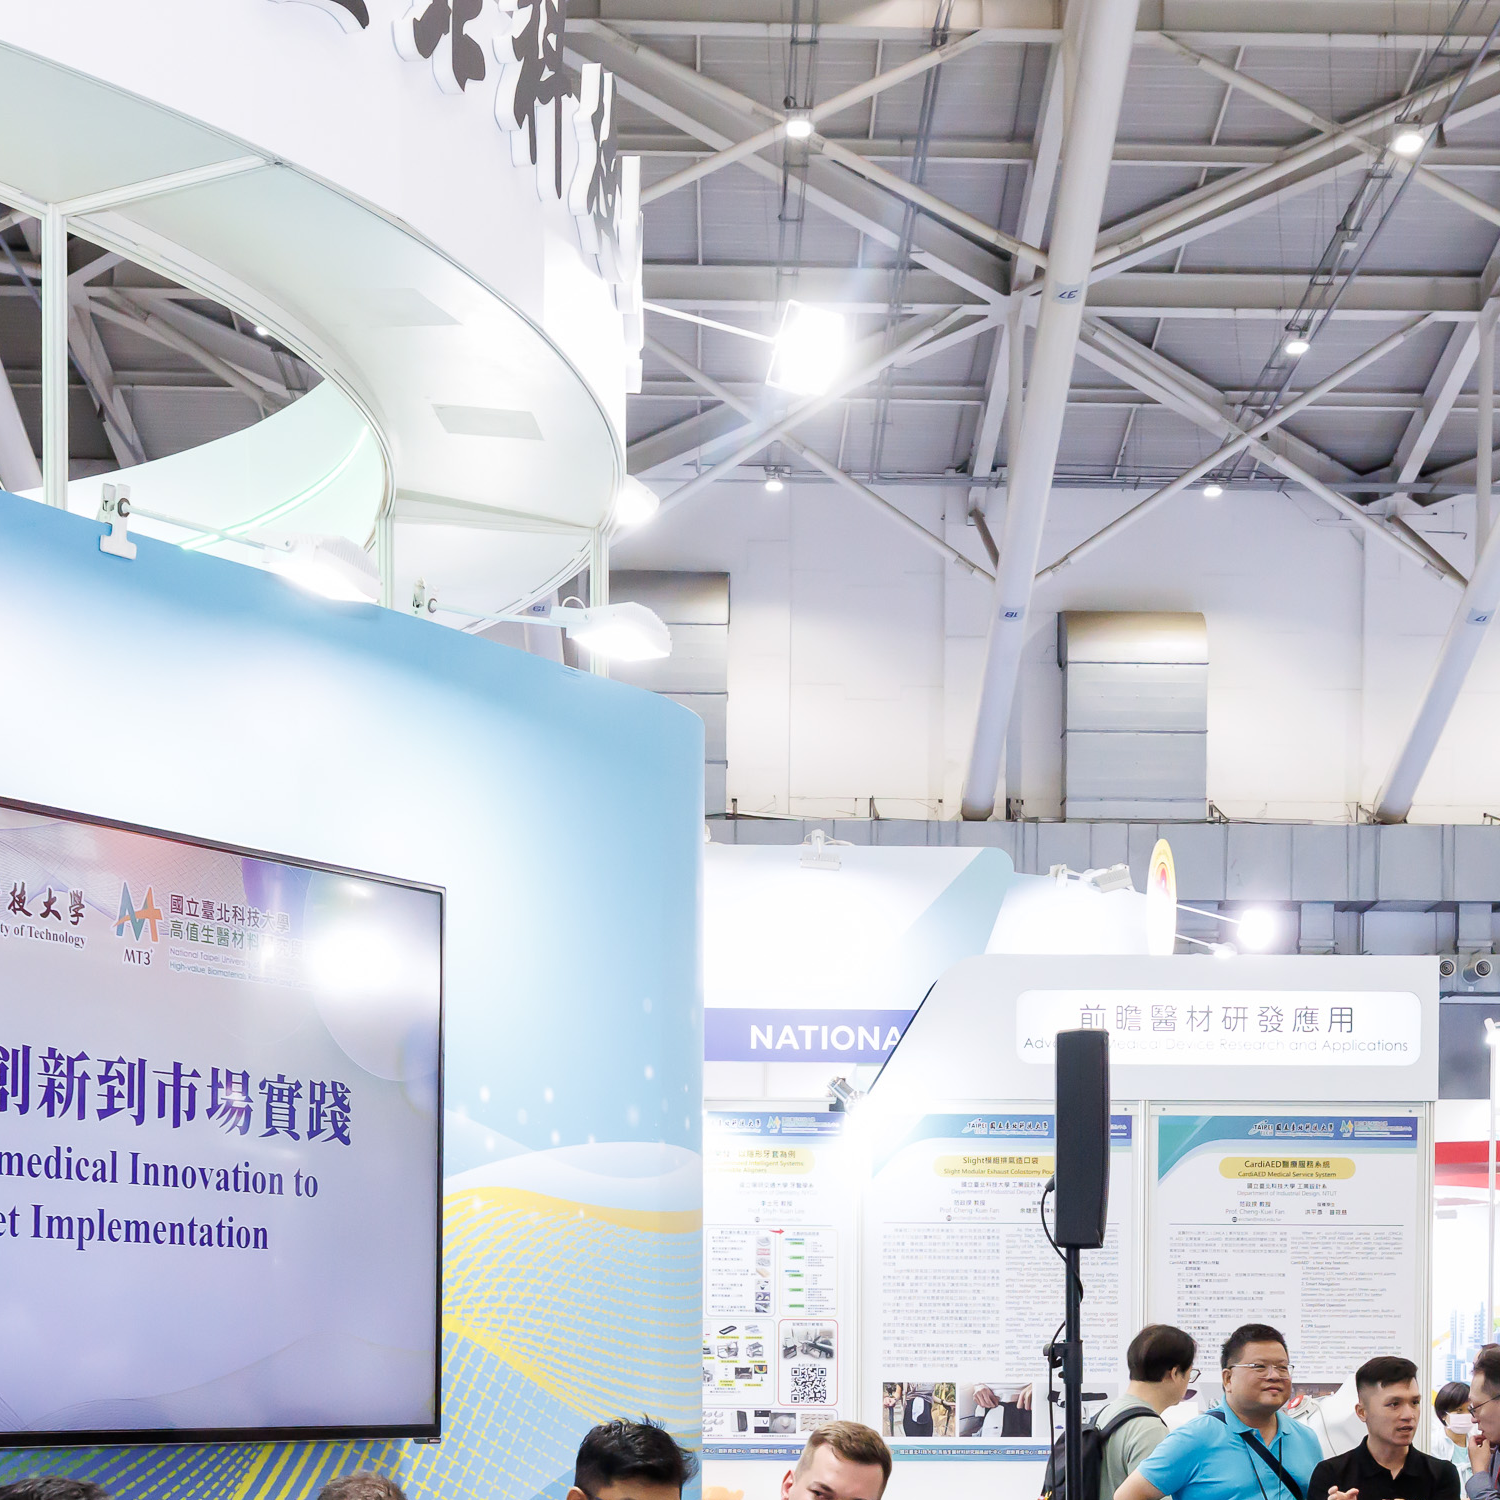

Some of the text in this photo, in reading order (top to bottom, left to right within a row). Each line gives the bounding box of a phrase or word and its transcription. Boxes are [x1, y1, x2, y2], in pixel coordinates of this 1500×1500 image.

[169, 893, 290, 933] 國立臺北科技大學
[13, 924, 26, 937] of
[27, 925, 86, 948] Technology
[1078, 1004, 1354, 1033] 前瞻醫材研發應用
[1166, 1037, 1214, 1051] Device
[1220, 1038, 1286, 1052] Research
[1290, 1038, 1318, 1052] and
[1320, 1038, 1408, 1054] Applications
[128, 1150, 286, 1198] Innovation
[293, 1171, 319, 1198] to
[944, 1168, 960, 1176] Slight
[1238, 1170, 1266, 1178] CardiAED
[30, 1202, 270, 1252] Implementation
